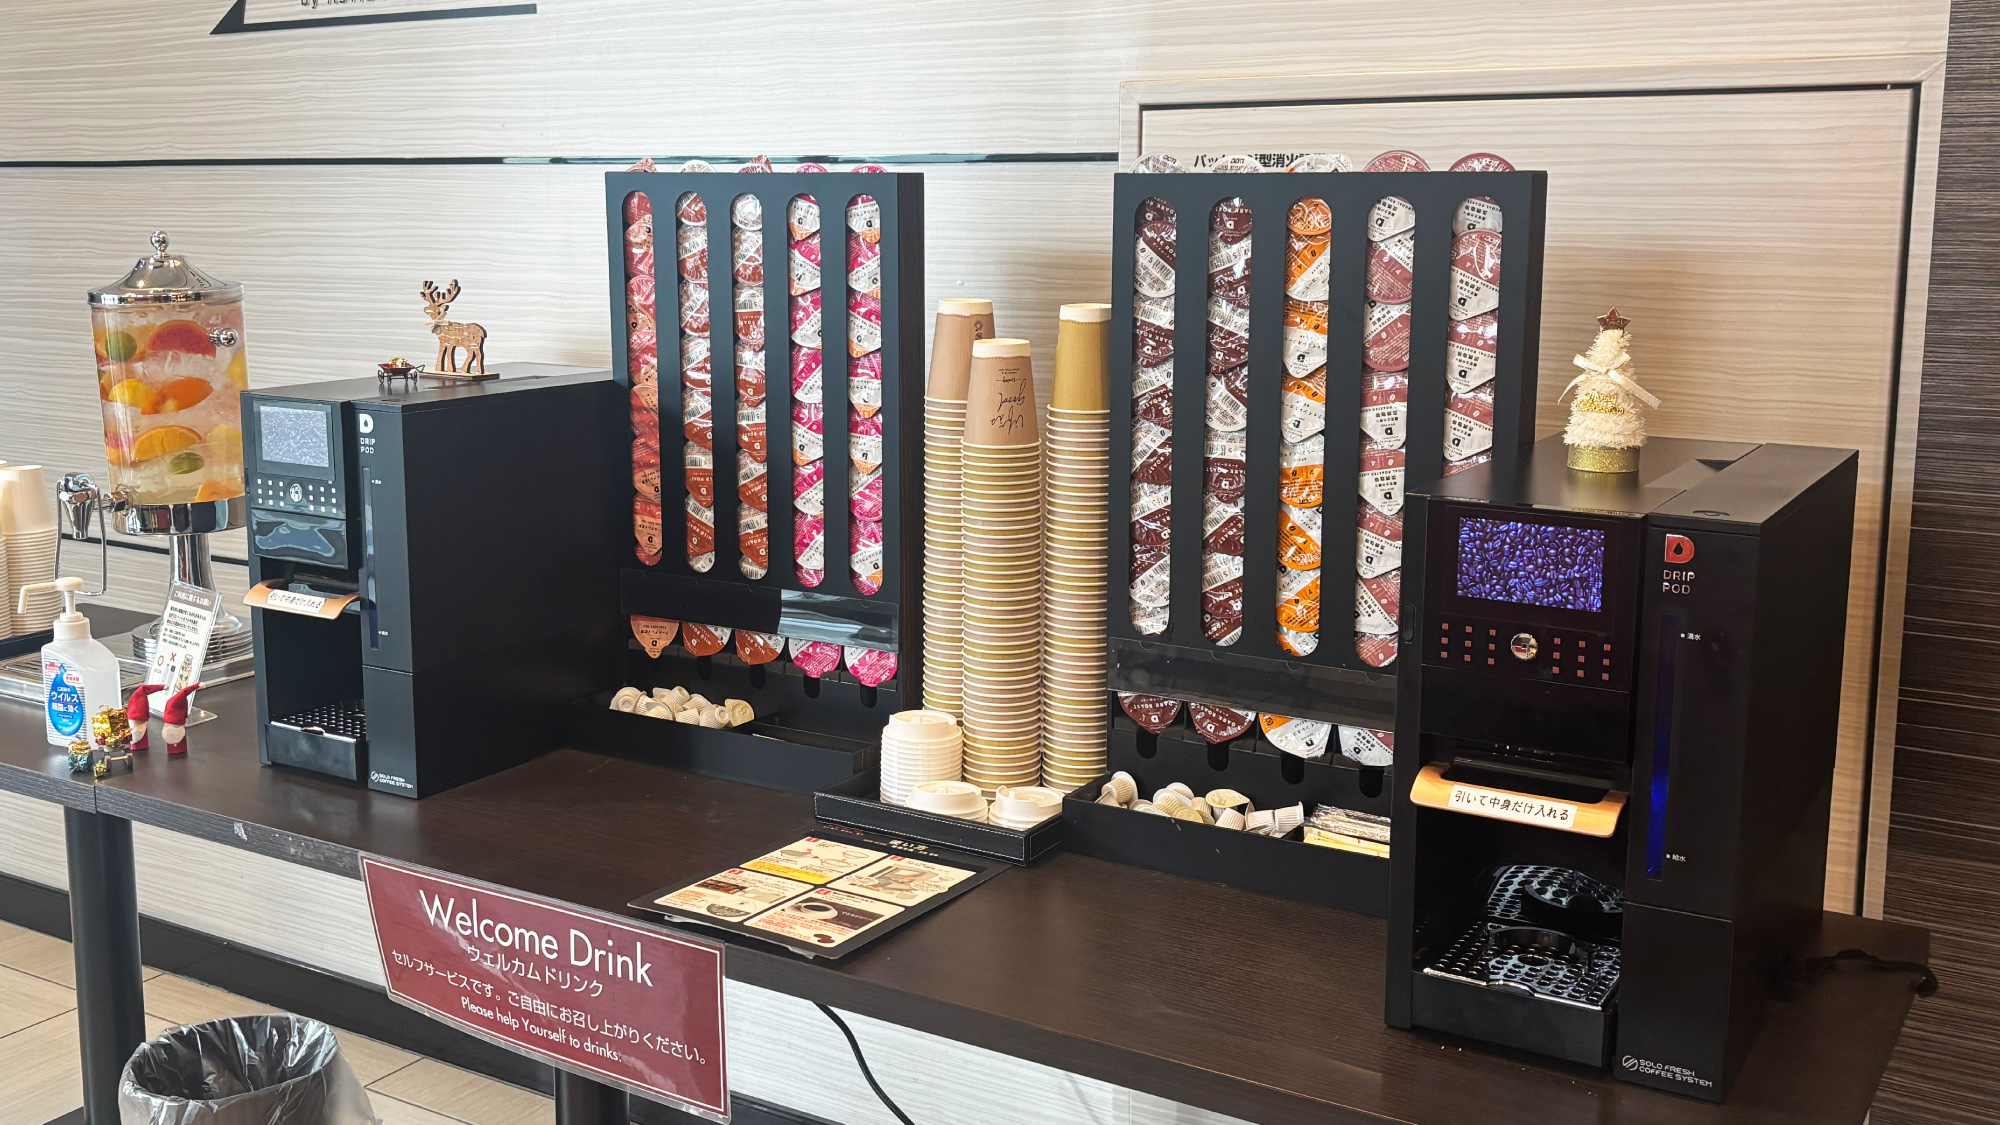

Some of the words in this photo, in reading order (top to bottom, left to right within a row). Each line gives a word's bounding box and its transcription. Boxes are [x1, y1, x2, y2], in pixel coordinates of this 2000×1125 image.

[998, 379, 1026, 413] good
[1663, 570, 1696, 581] DRIP
[1662, 582, 1691, 595] POD
[700, 634, 712, 646] MILD
[754, 642, 766, 654] MILD
[51, 691, 79, 703] ウイルス
[51, 703, 79, 713] 細菌に効く
[1218, 716, 1236, 727] DARK
[1454, 789, 1570, 821] 引いて中身だけ入れる
[889, 839, 929, 851] 使い方
[419, 889, 559, 960] Welcome
[569, 928, 654, 988] Drink
[466, 945, 604, 998] ウェルカムドリンク
[461, 996, 494, 1020] Please
[496, 1006, 519, 1030] help
[522, 1014, 566, 1045] Yourself
[569, 1034, 581, 1048] to
[1639, 1059, 1662, 1070] SOLO
[1664, 1064, 1695, 1077] FRESH
[1639, 1066, 1673, 1079] COFFEE
[1675, 1073, 1712, 1088] SYSTEM
